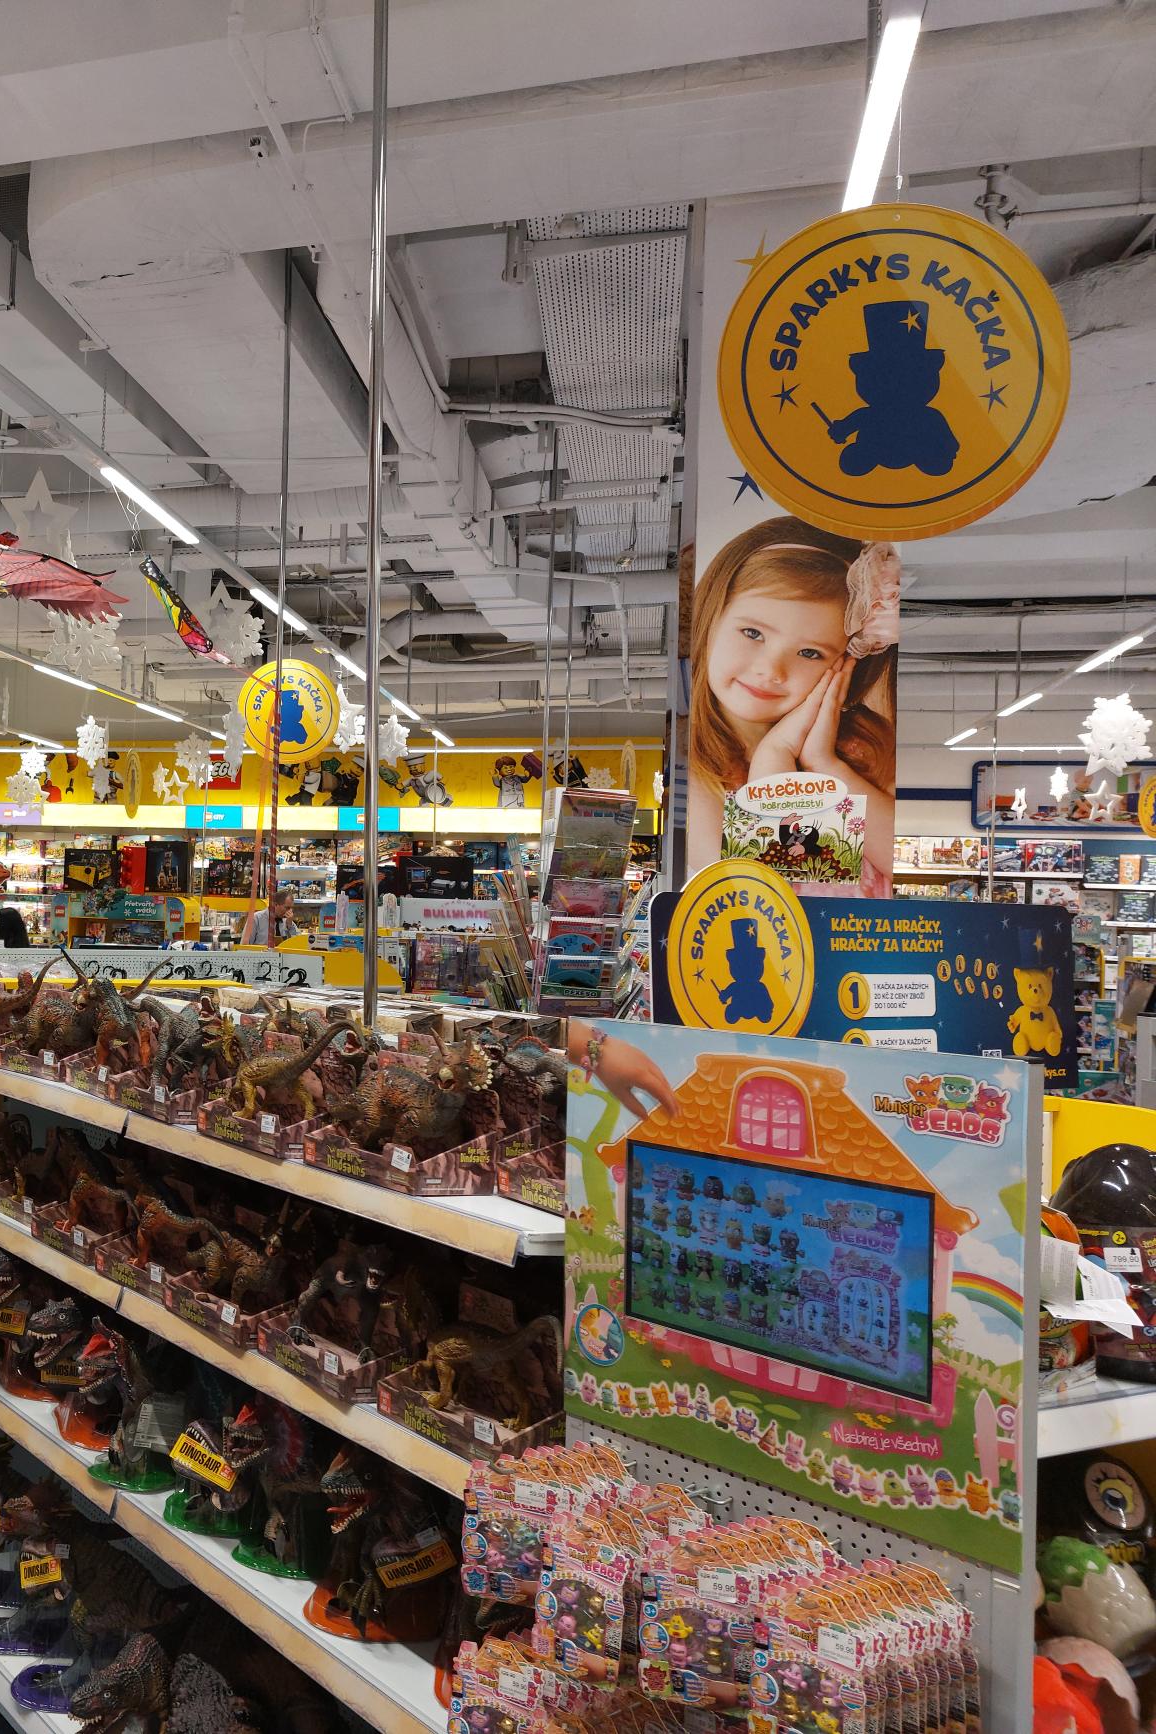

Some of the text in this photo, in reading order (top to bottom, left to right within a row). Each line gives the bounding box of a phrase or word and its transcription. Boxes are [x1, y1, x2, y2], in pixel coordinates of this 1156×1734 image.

[770, 253, 1011, 372] SPARKYS KAČKA
[297, 678, 324, 712] KAČKA
[748, 778, 836, 800] Krtečkova
[692, 890, 792, 960] SPARKYS KAČKA
[830, 913, 942, 935] KAČKY ZA HRAČKY,
[830, 933, 944, 953] HRAČKY ZA KAČKY!
[849, 982, 859, 1008] 1
[877, 982, 895, 990] KAČKA
[904, 982, 929, 990] KAŽDÝCH
[882, 992, 890, 1000] KČ
[909, 992, 925, 1000] ZBOŽÍ
[880, 1038, 898, 1046] KAČKY
[874, 1095, 927, 1118] Monster
[911, 1109, 1001, 1143] BEADS
[327, 1155, 366, 1178] Dinosaurs
[521, 1184, 563, 1211] Dinosaurs
[45, 1363, 78, 1377] DINOSAU
[404, 1409, 448, 1444] Dinosaurs
[833, 1423, 939, 1457] Nasbírej je všechny!
[179, 1441, 222, 1474] DINOSAUR
[467, 1518, 477, 1527] 3+
[23, 1562, 50, 1580] DINOSAUR
[386, 1555, 436, 1581] DINOSAUR
[755, 1653, 766, 1664] 3+
